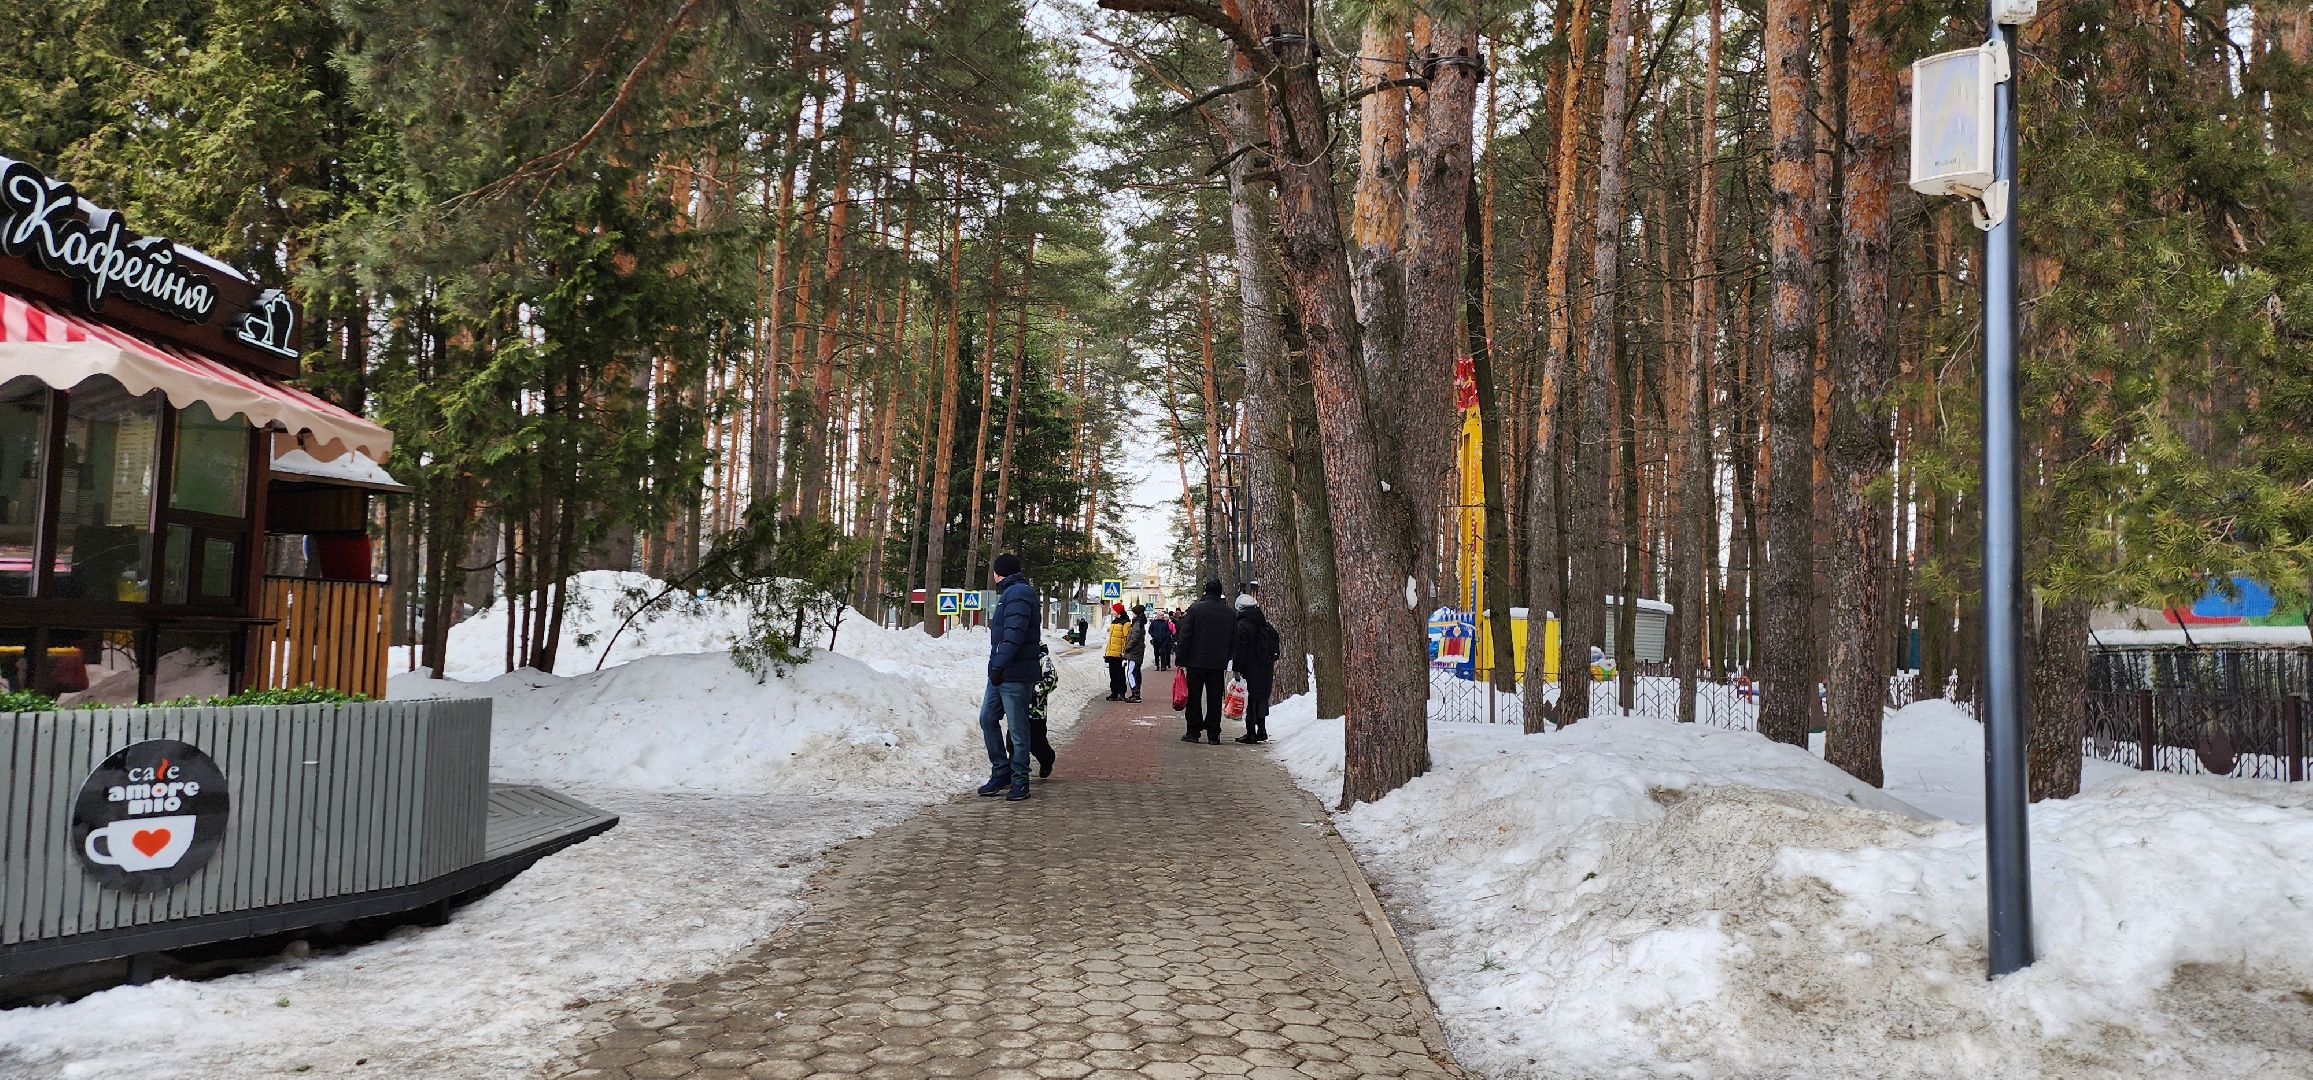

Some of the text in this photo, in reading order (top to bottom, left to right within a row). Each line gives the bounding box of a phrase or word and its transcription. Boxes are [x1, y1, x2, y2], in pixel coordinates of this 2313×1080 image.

[9, 175, 214, 314] Кофейня
[108, 781, 200, 802] amore
[128, 796, 182, 815] mio
